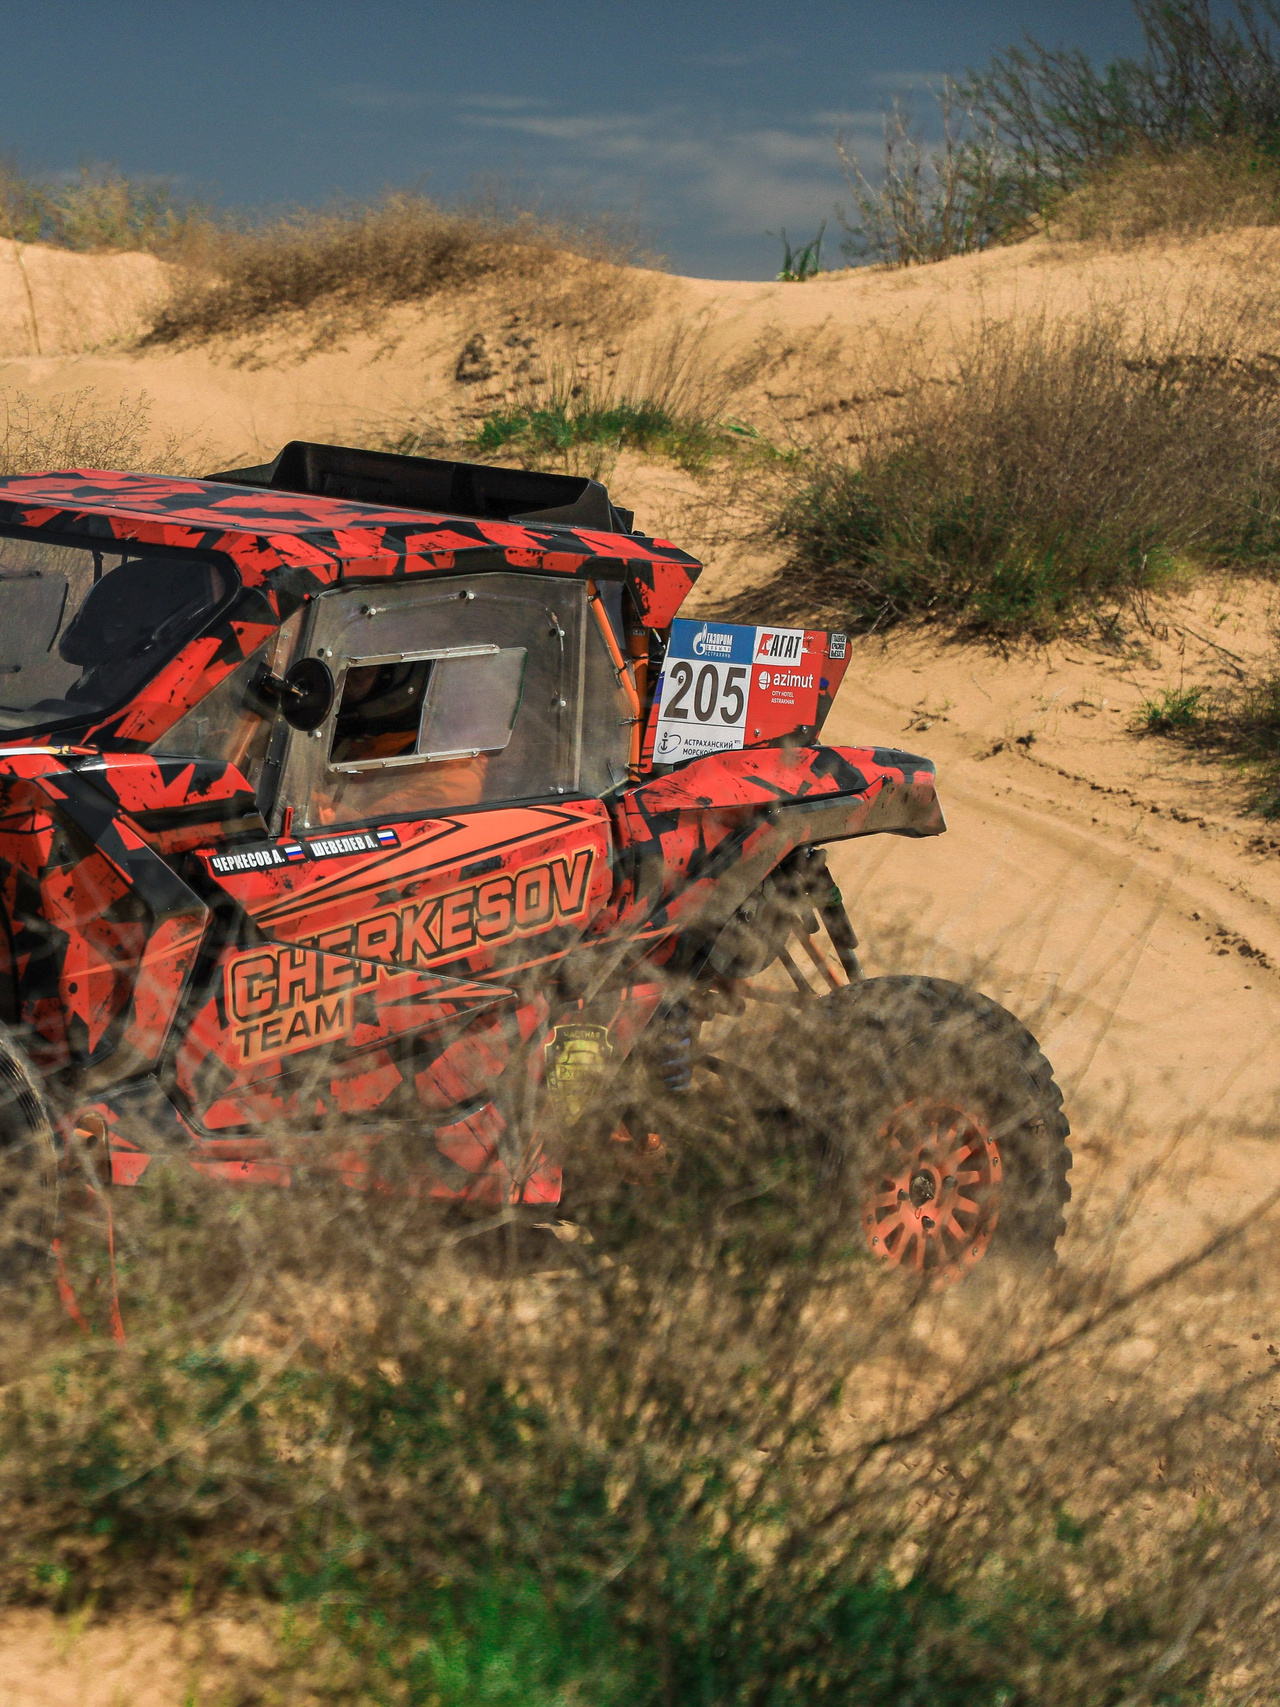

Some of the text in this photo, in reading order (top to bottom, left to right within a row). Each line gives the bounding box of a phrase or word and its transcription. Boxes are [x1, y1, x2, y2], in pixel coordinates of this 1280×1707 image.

[705, 632, 733, 646] ГАЗПРОМ
[770, 634, 801, 658] АГАТ
[704, 651, 731, 659] АСТРАХАНЬ
[773, 670, 813, 688] azimut
[663, 661, 747, 724] 205
[770, 697, 795, 705] ASTRAKHAN
[684, 738, 734, 749] АСТРАХАНСКИЙ
[310, 836, 366, 857] ШЕВЕЛЕВ
[212, 850, 272, 871] ЧЕРКЕСОВ
[231, 848, 594, 1024] CHERKESOV
[235, 1002, 345, 1058] TEAM
